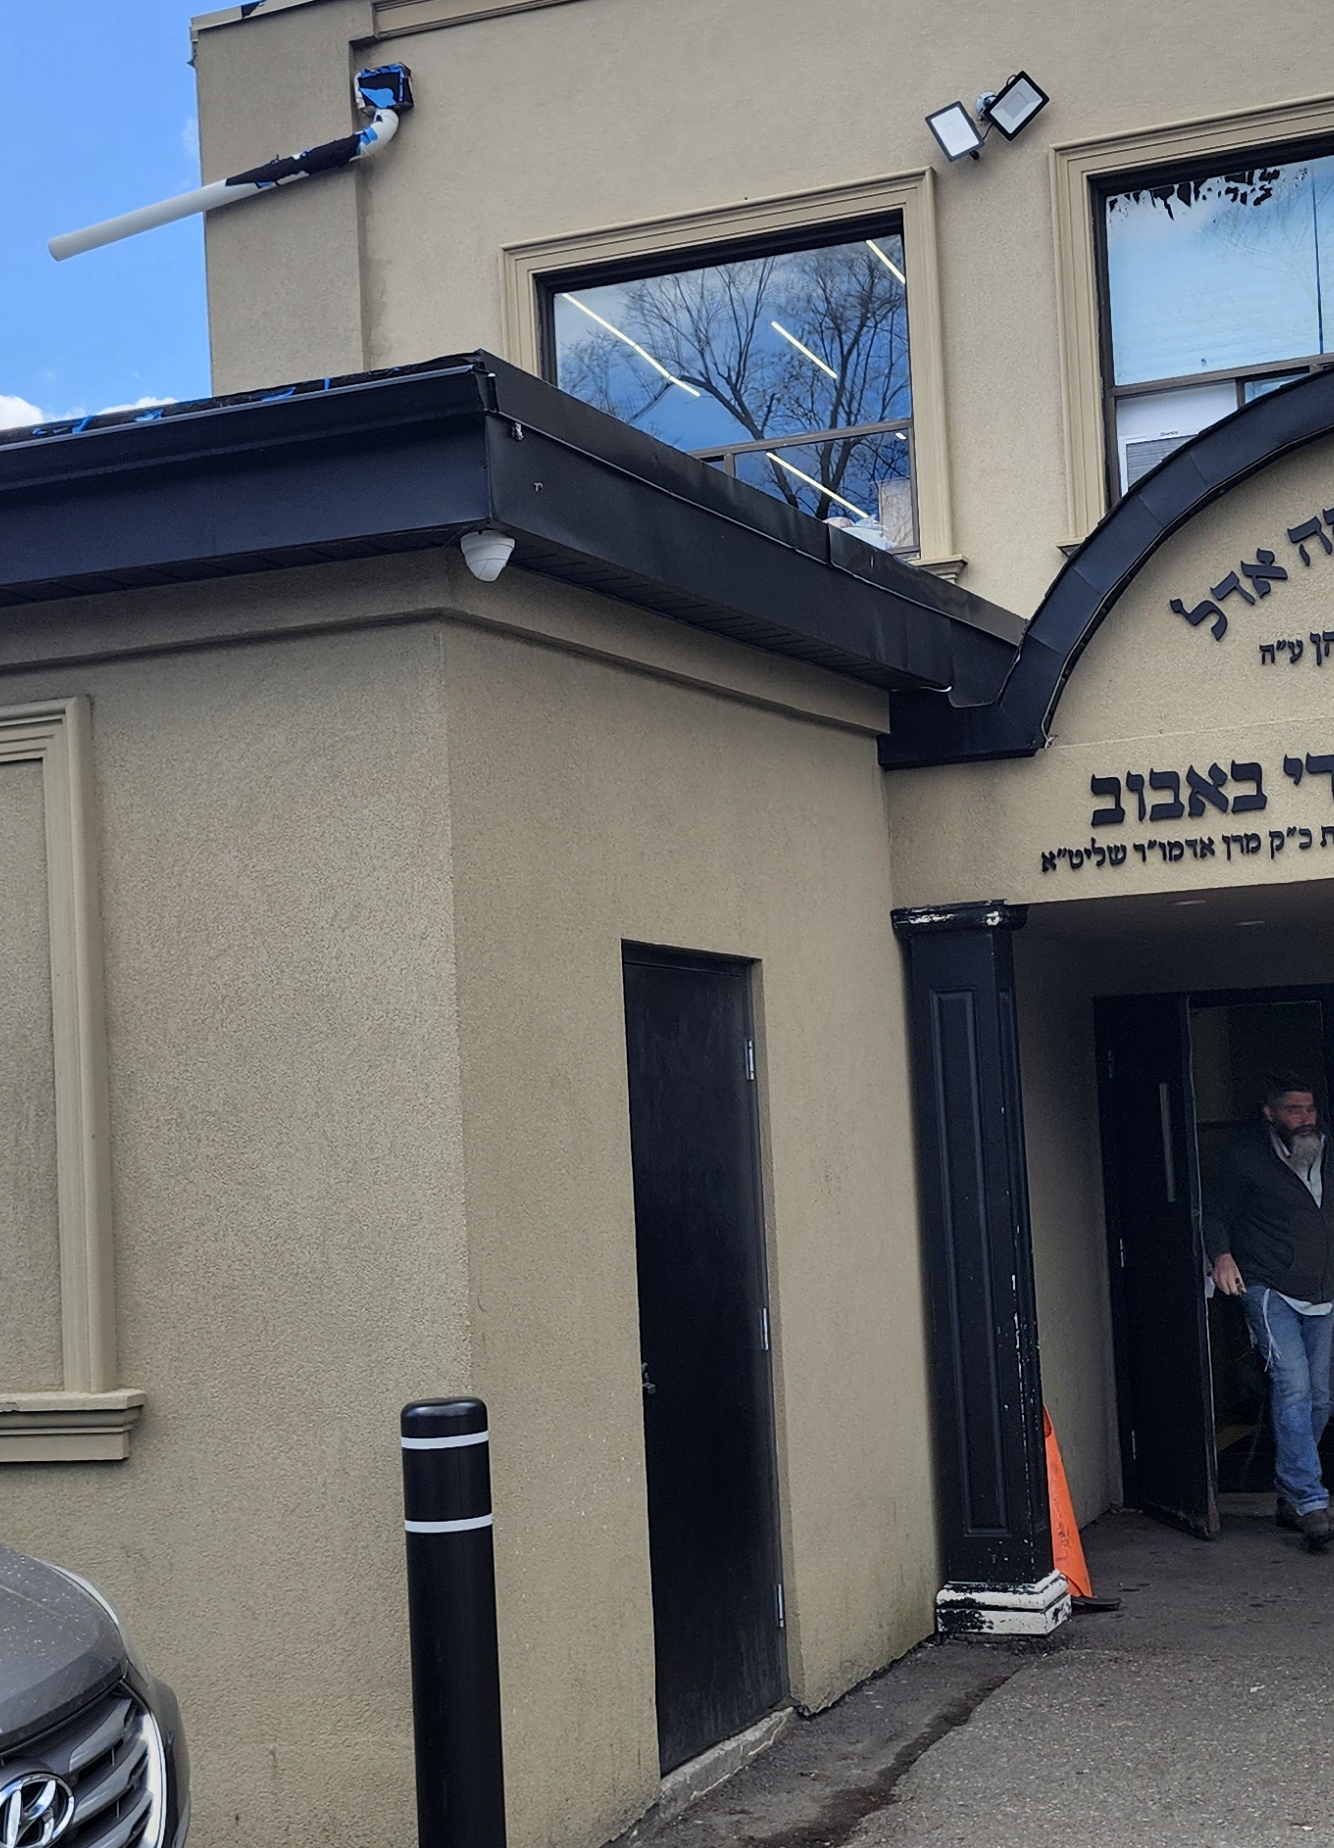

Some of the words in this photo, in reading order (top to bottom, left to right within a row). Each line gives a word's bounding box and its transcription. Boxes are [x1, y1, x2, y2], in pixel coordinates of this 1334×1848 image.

[1169, 547, 1289, 642] אדל
[1090, 759, 1268, 829] באבוב
[1221, 832, 1262, 862] מרן
